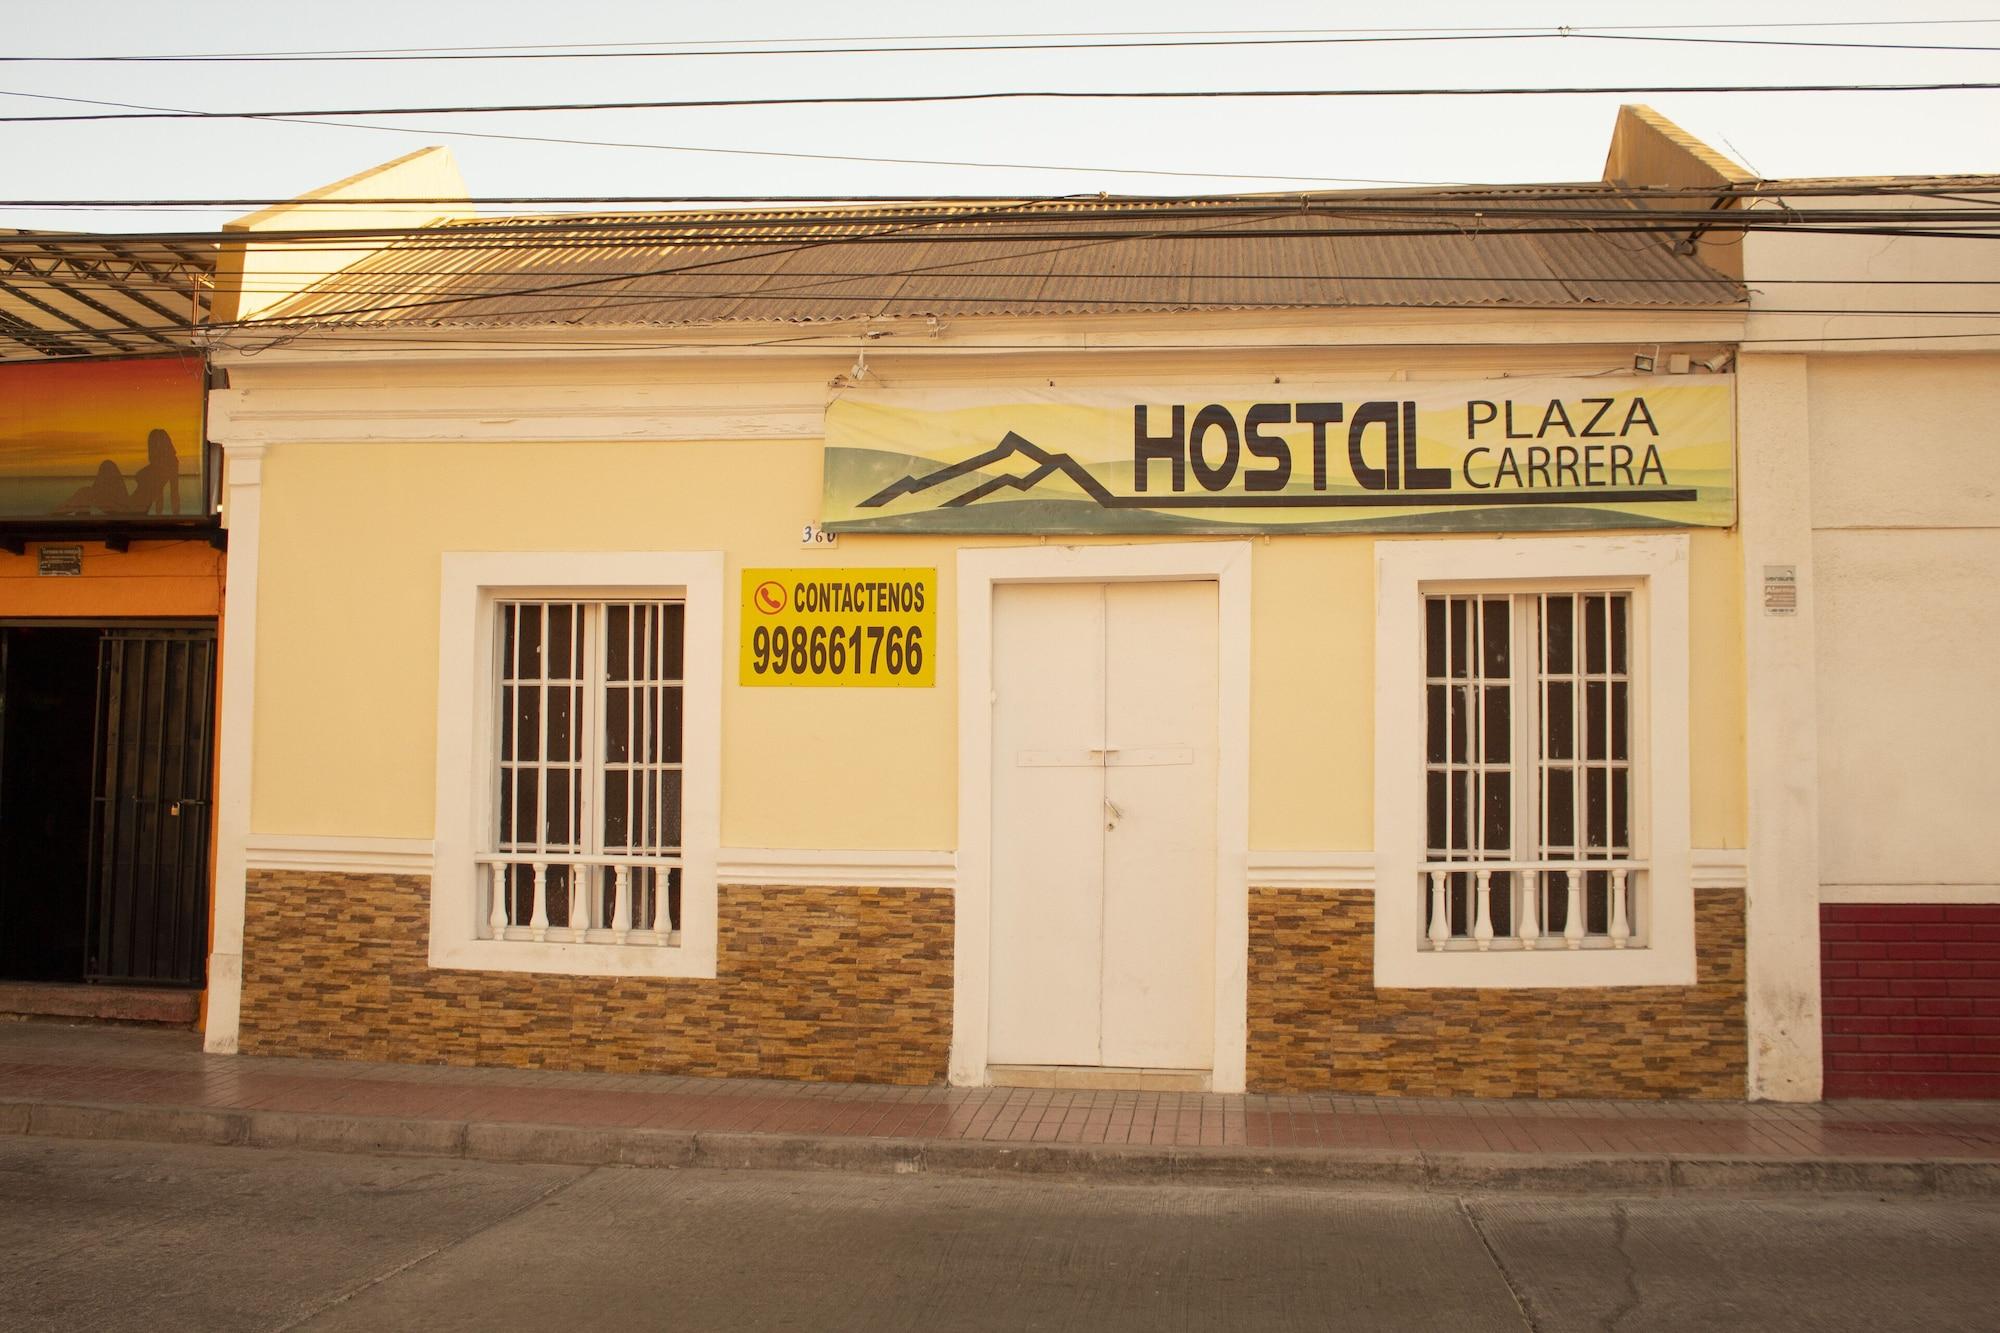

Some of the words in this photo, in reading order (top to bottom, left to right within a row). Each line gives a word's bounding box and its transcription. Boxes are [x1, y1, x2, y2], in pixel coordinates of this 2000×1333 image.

[1467, 397, 1660, 439] PLAZA
[1463, 444, 1668, 489] CARRERA
[794, 582, 925, 613] CONTACTENOS
[753, 625, 923, 675] 998661766
